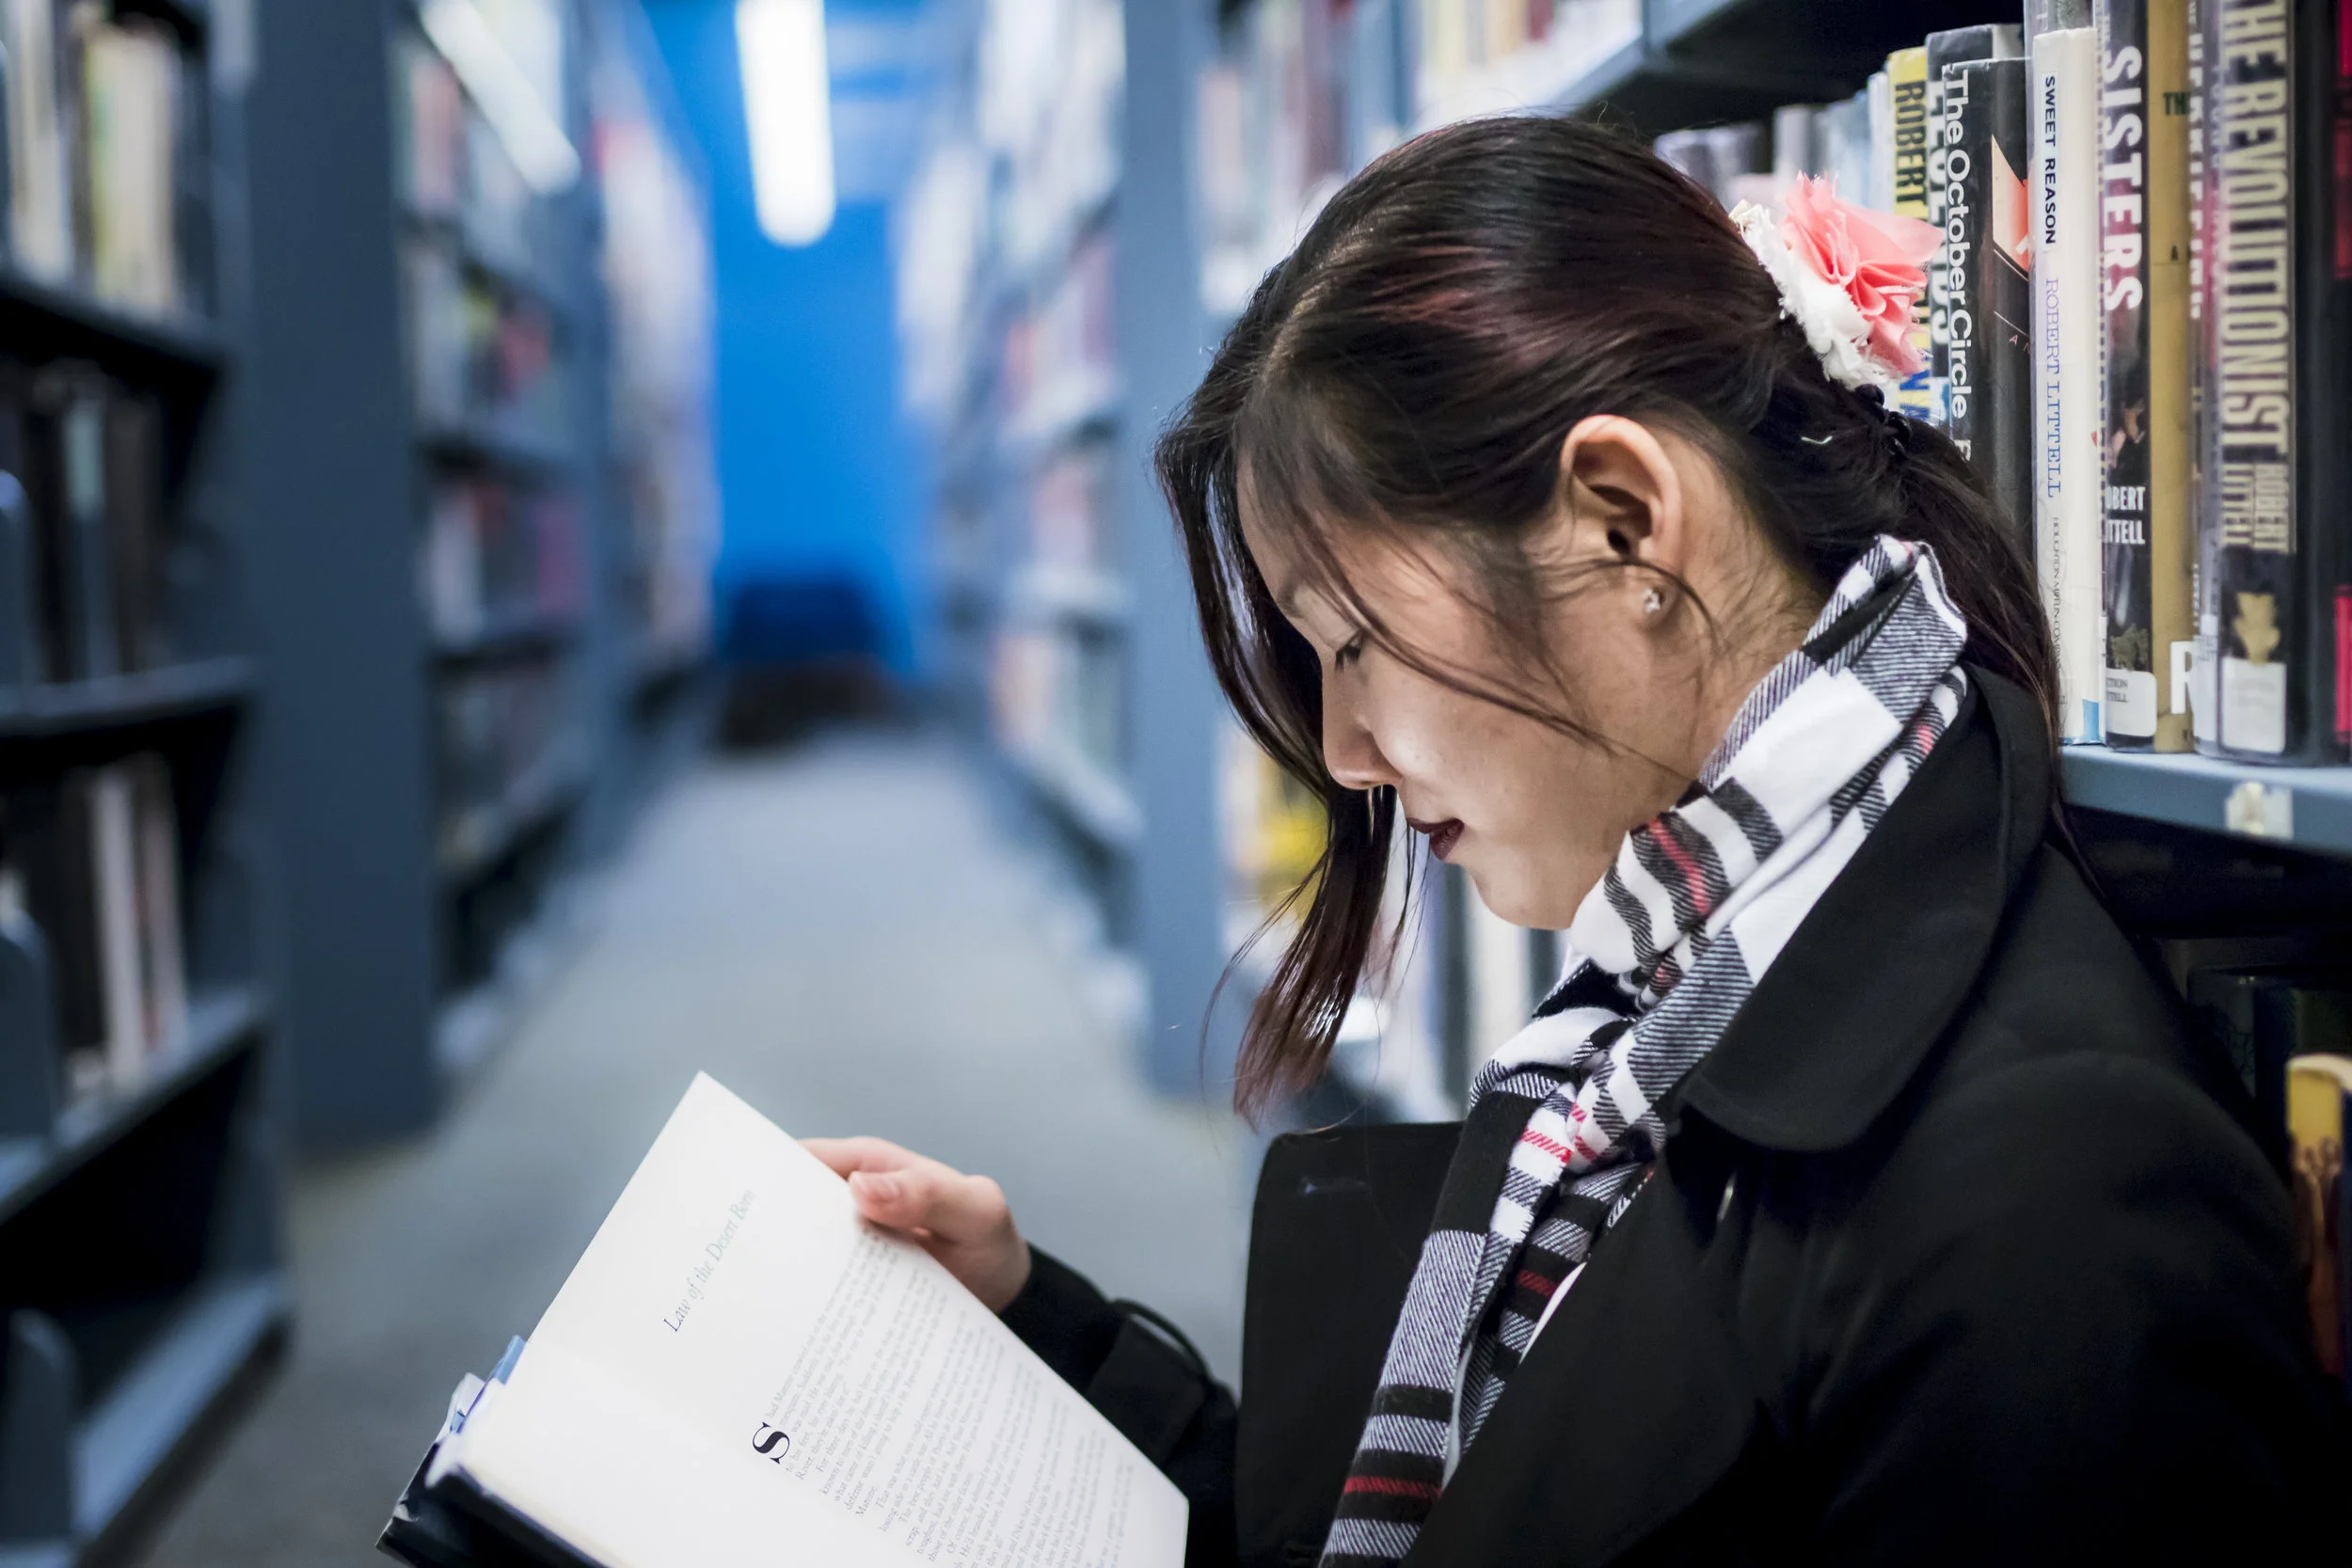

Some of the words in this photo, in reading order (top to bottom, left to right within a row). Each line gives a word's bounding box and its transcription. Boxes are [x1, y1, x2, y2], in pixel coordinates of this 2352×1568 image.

[1945, 70, 1968, 144] The
[2044, 75, 2057, 147] SWEET
[1894, 82, 1927, 206] ROBERT
[2044, 157, 2058, 245] REASON
[2103, 46, 2142, 311] SISTERS
[1946, 149, 1971, 305] October
[2218, 79, 2290, 454] REVOLUTIONIST
[2045, 277, 2060, 375] ROBERT
[1949, 309, 1973, 419] Circle
[2046, 381, 2062, 499] LITTELL
[2105, 485, 2146, 511] OBERT
[2253, 463, 2289, 553] ROBERT
[2051, 516, 2060, 578] HOUGHTON
[706, 1219, 739, 1261] Desert
[686, 1276, 706, 1300] of
[693, 1260, 715, 1284] the
[664, 1298, 691, 1332] Law
[751, 1421, 790, 1464] S
[816, 1458, 828, 1473] For
[825, 1435, 840, 1455] three
[819, 1466, 839, 1496] known
[834, 1482, 847, 1501] what
[846, 1461, 858, 1481] came
[844, 1480, 864, 1510] defense
[875, 1490, 889, 1508] That
[895, 1455, 907, 1474] what
[898, 1507, 912, 1523] The
[917, 1465, 931, 1492] people
[917, 1507, 927, 1523] and
[923, 1490, 935, 1507] they
[879, 1508, 898, 1533] losing
[928, 1541, 942, 1561] those
[951, 1496, 962, 1515] other
[960, 1537, 974, 1557] He'd
[968, 1508, 987, 1538] branded
